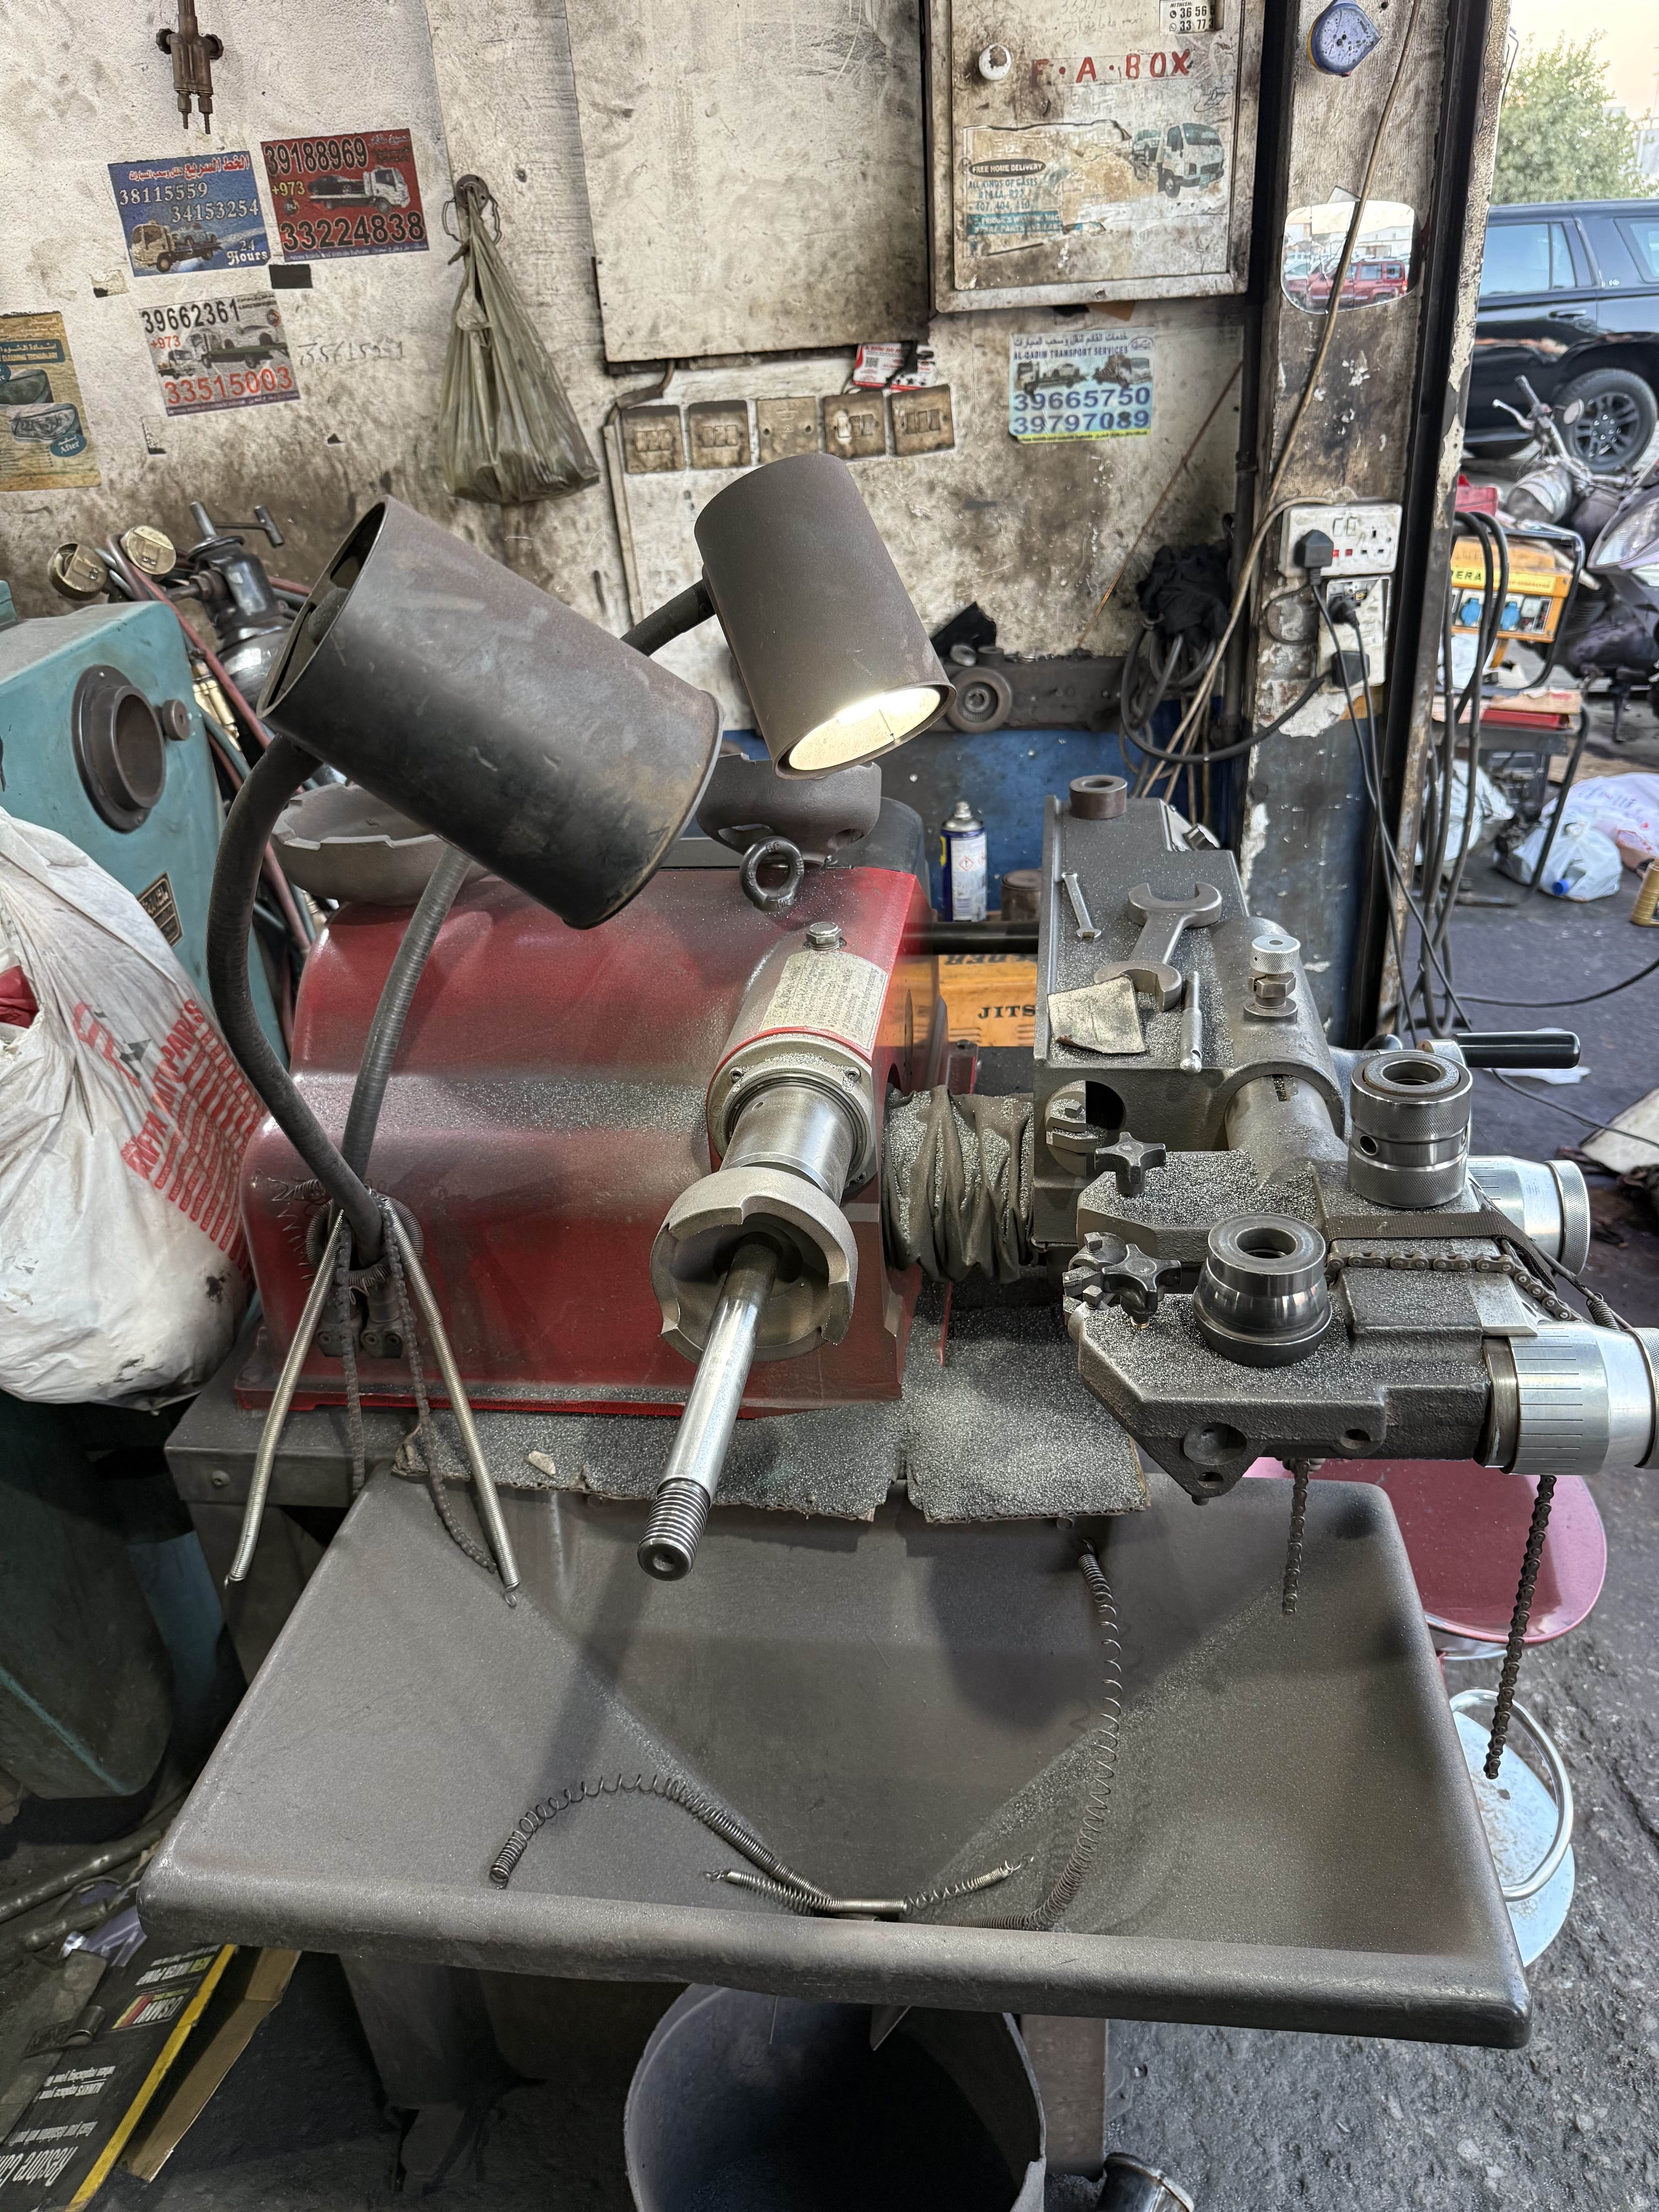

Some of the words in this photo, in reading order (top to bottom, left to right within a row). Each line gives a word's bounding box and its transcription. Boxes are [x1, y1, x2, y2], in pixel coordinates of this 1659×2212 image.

[1180, 7, 1192, 19] 36
[1195, 5, 1207, 17] 56
[1180, 19, 1192, 31] 33
[1197, 19, 1206, 30] 77
[223, 155, 250, 172] الخط
[264, 137, 368, 176] 39188969
[972, 165, 989, 174] FREE
[990, 164, 1010, 173] HOME
[1010, 162, 1043, 171] DELIVERY
[184, 157, 222, 180] السريع
[119, 182, 208, 206] 38115559
[271, 180, 306, 196] +973
[172, 198, 259, 223] 34153254
[280, 210, 426, 252] 33224838
[239, 239, 255, 252] 24
[226, 251, 268, 265] Hours
[142, 297, 240, 333] 39662361
[150, 335, 181, 349] +973
[1050, 347, 1092, 359] TRANSPORT
[1093, 345, 1128, 356] SERVICES
[164, 366, 293, 405] 33515003
[1013, 387, 1150, 412] 39665750
[1013, 410, 1149, 434] 39797089
[160, 999, 205, 1072] PARTS
[12, 2146, 79, 2187] Restore
